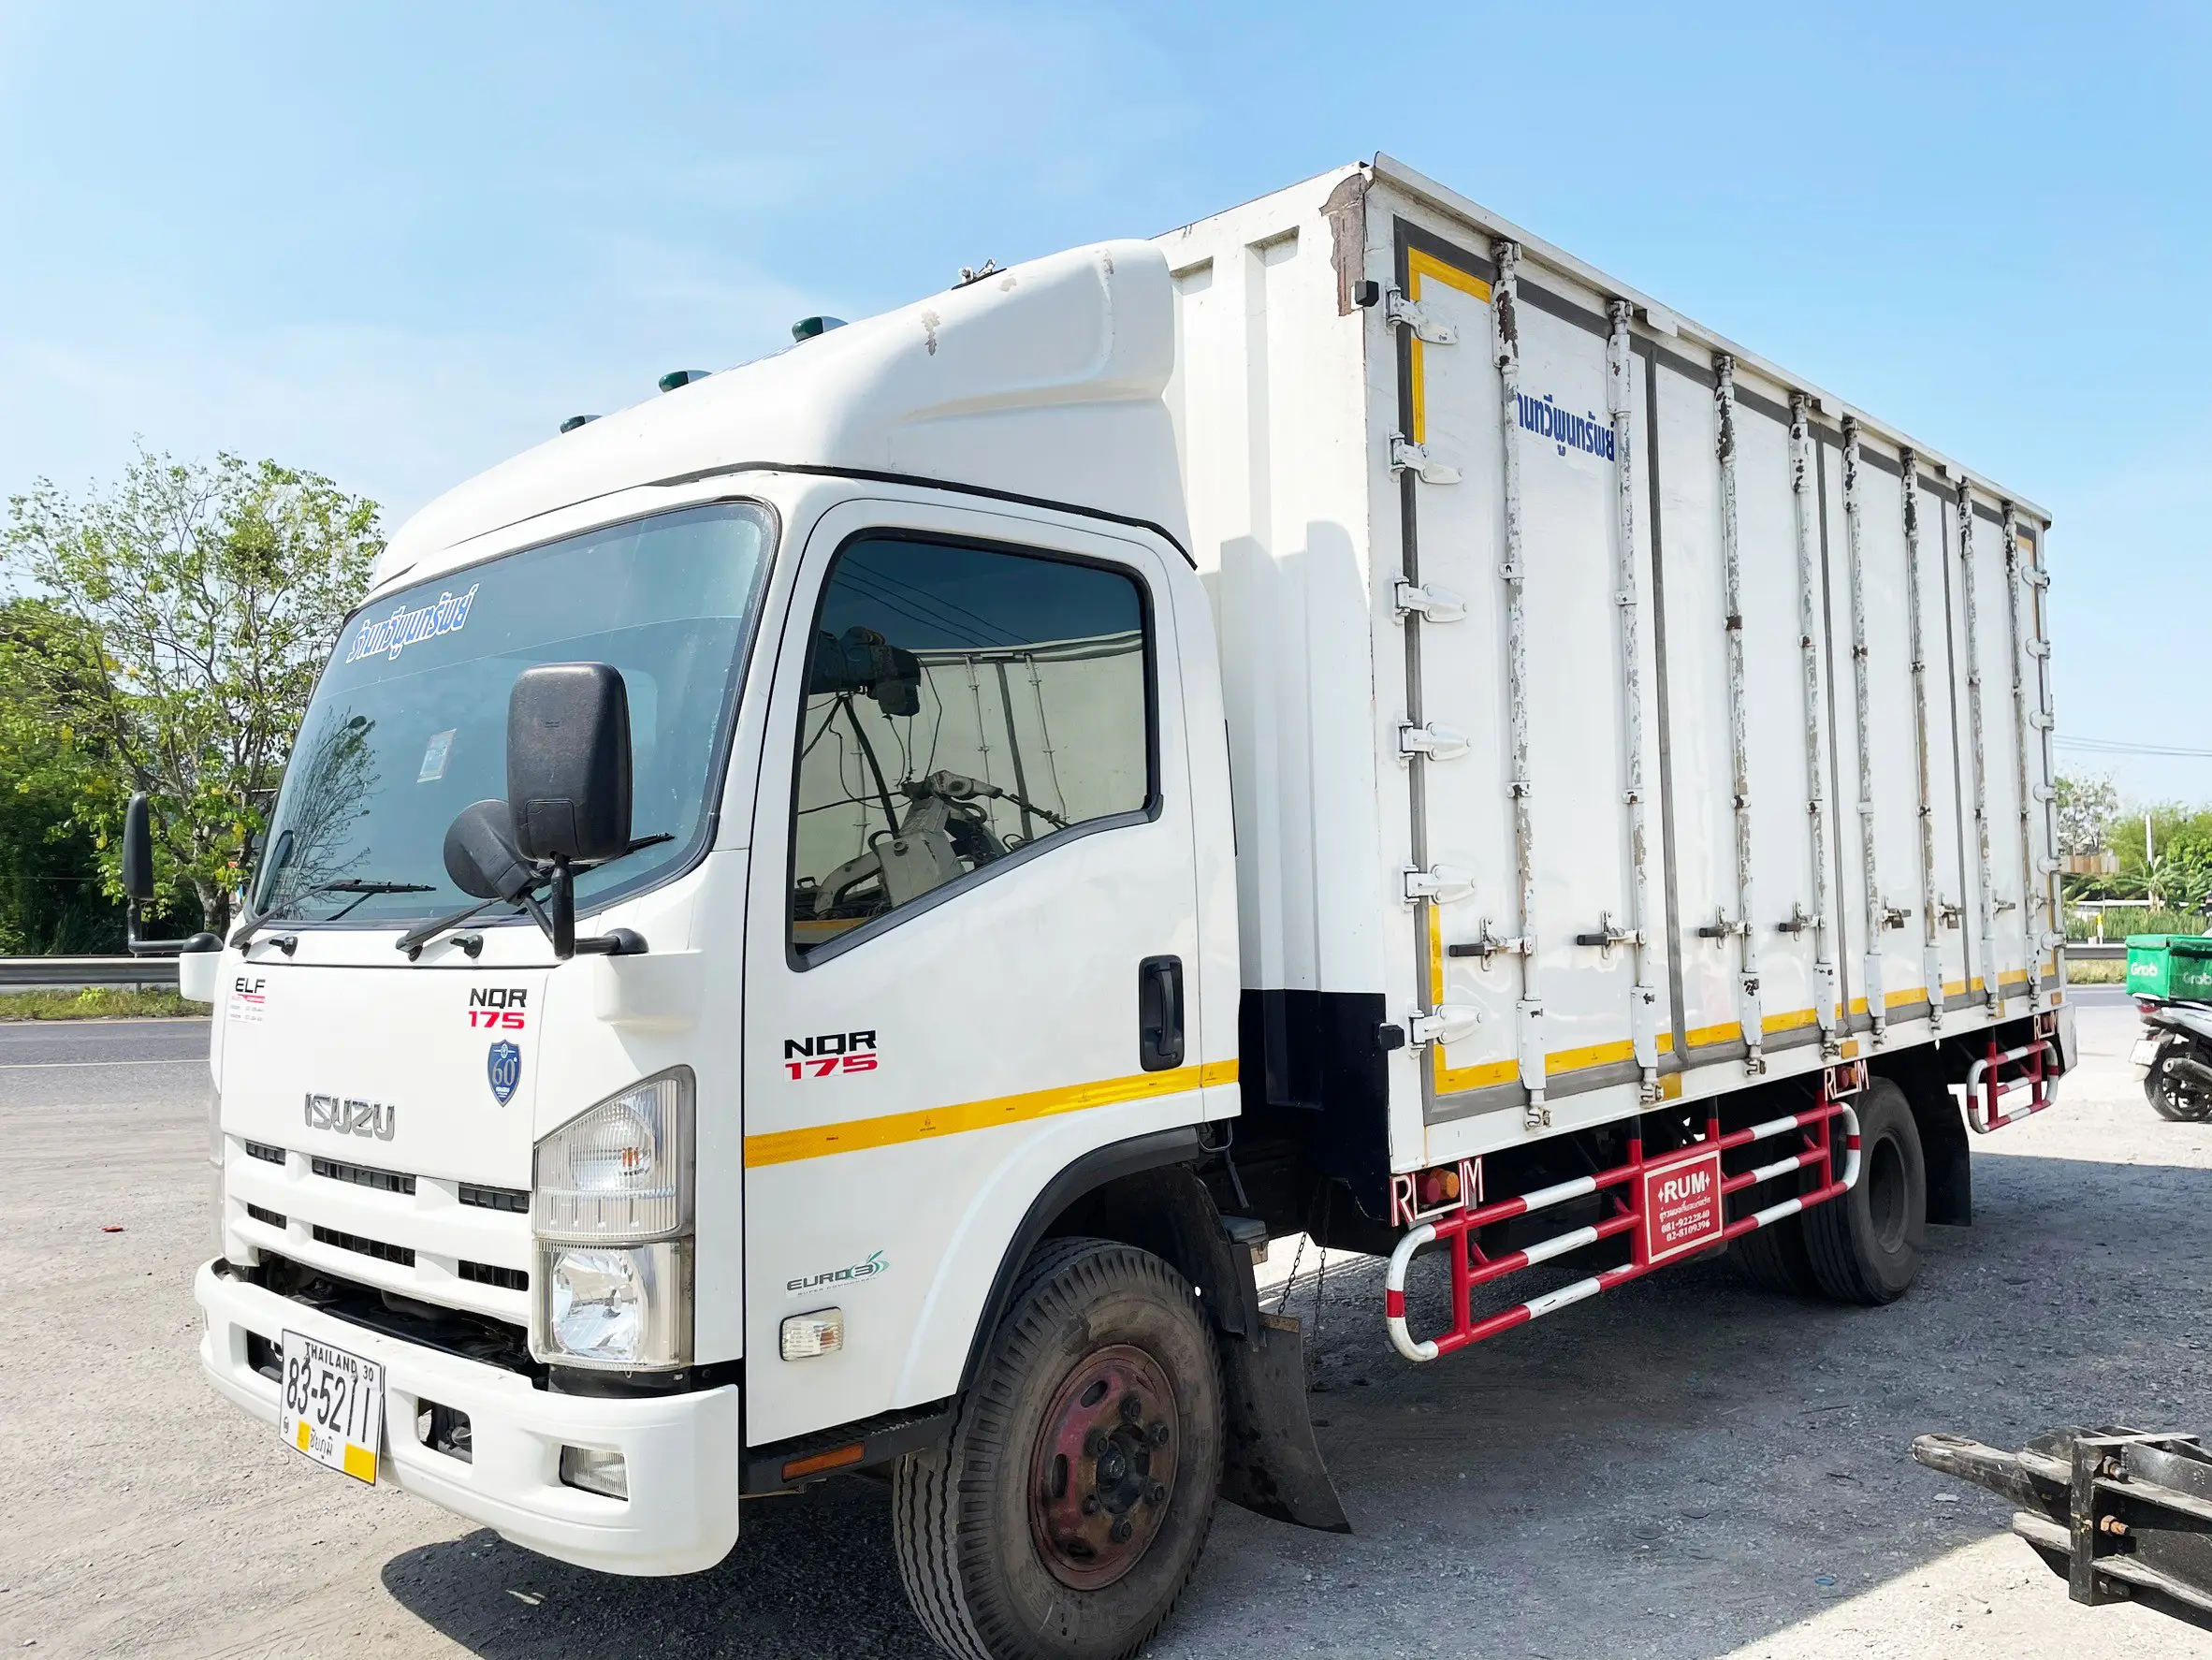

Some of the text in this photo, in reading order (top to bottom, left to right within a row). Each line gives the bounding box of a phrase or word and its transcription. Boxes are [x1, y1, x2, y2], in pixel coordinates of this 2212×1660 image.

[2130, 962, 2158, 977] Grab
[2183, 971, 2212, 985] Grab
[235, 977, 267, 994] ELF
[469, 987, 528, 1009] NQR
[468, 1010, 525, 1029] 175
[784, 1029, 878, 1059] NQR
[784, 1053, 879, 1081] 175
[304, 1091, 396, 1142] ISUZU
[1664, 1171, 1707, 1203] RUM
[1661, 1209, 1710, 1234] 081-9222840
[1666, 1218, 1711, 1242] 02-8109396
[305, 1341, 374, 1382] THAILAND 30
[286, 1357, 371, 1443] 83-5211
[310, 1428, 333, 1460] ชัยภูมิ
